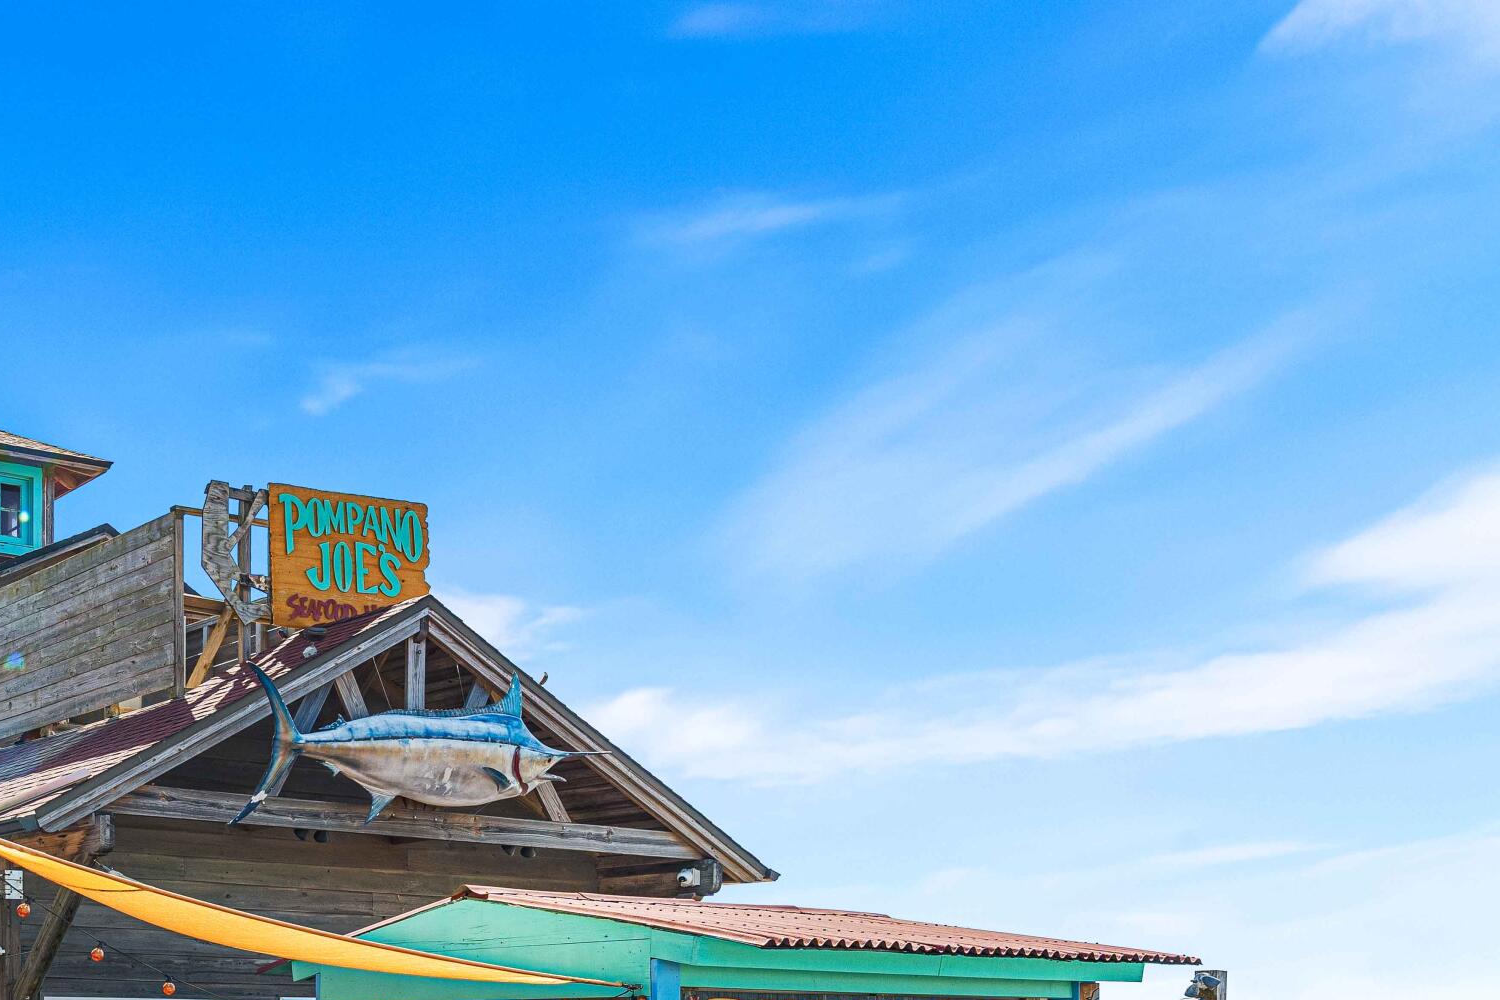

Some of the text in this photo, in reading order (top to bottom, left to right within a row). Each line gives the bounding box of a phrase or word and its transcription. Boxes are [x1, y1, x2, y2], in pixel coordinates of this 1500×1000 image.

[278, 493, 423, 563] POMPANO
[305, 541, 401, 598] JOE'S
[286, 593, 358, 622] SEAFOOD
